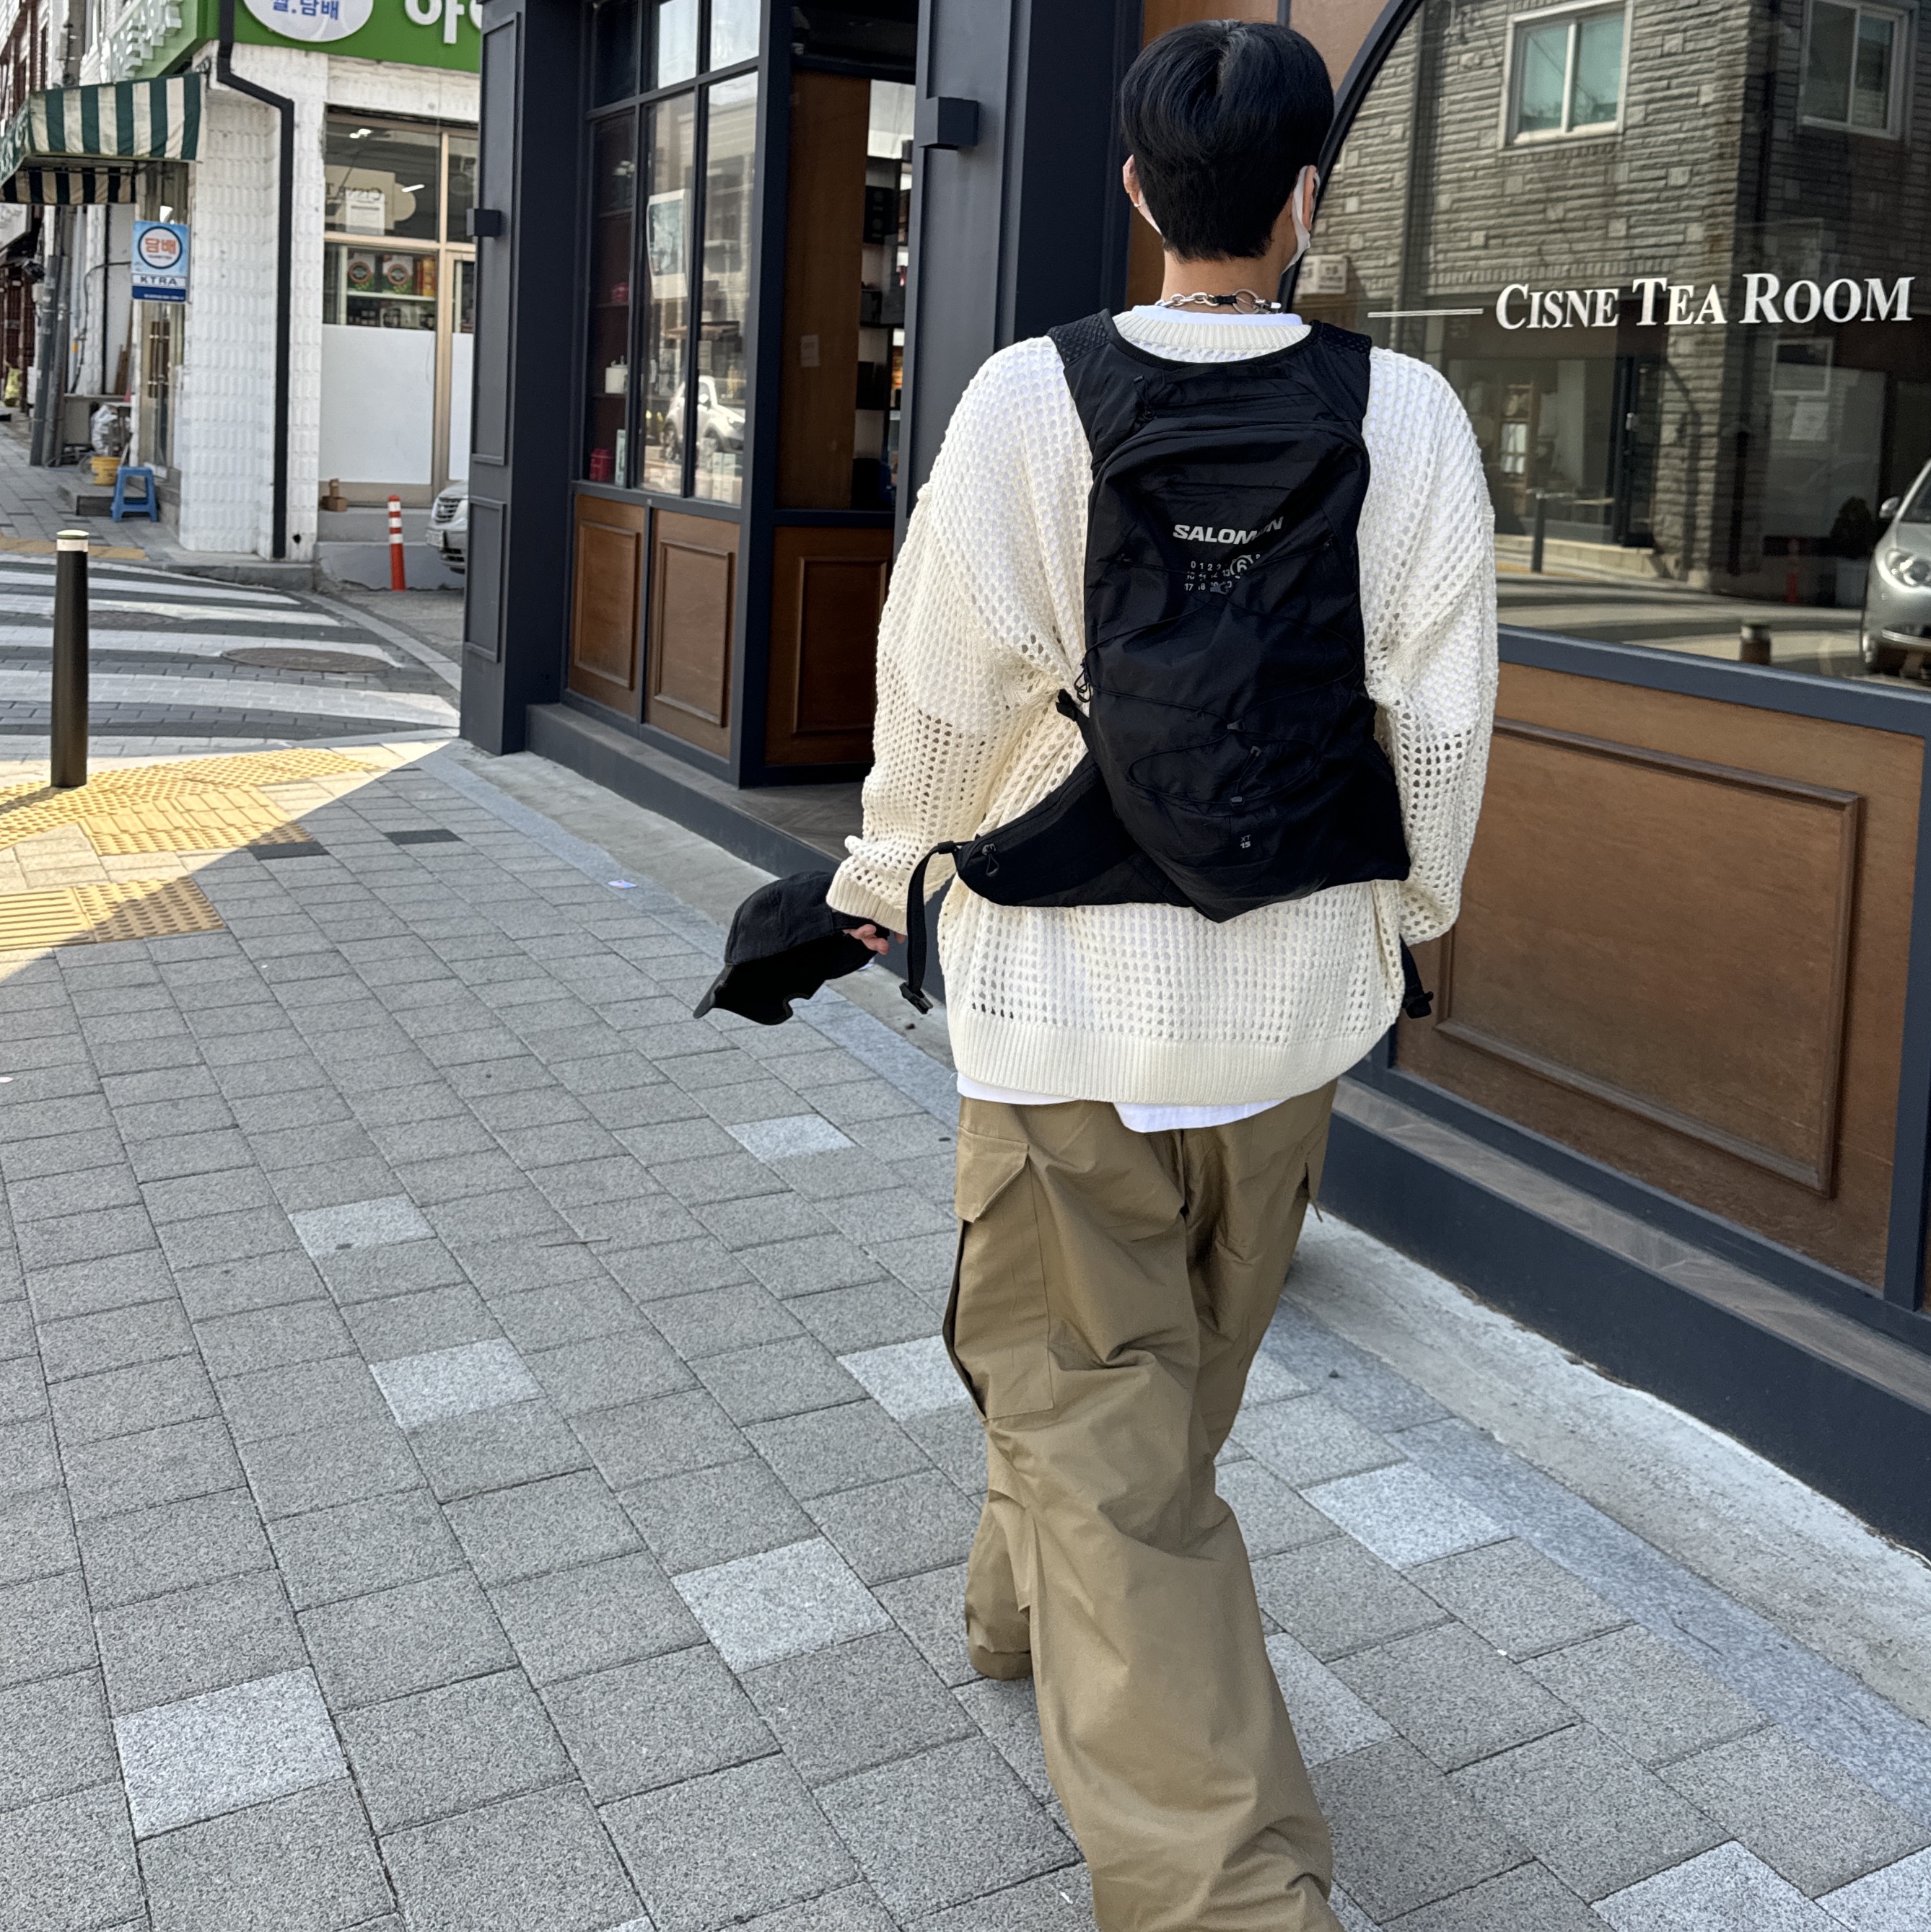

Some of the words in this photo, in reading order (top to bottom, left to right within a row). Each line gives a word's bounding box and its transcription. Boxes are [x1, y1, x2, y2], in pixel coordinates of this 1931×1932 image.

[1495, 284, 1620, 330] CISNE
[1632, 277, 1728, 327] TEA
[1738, 273, 1917, 324] ROOM
